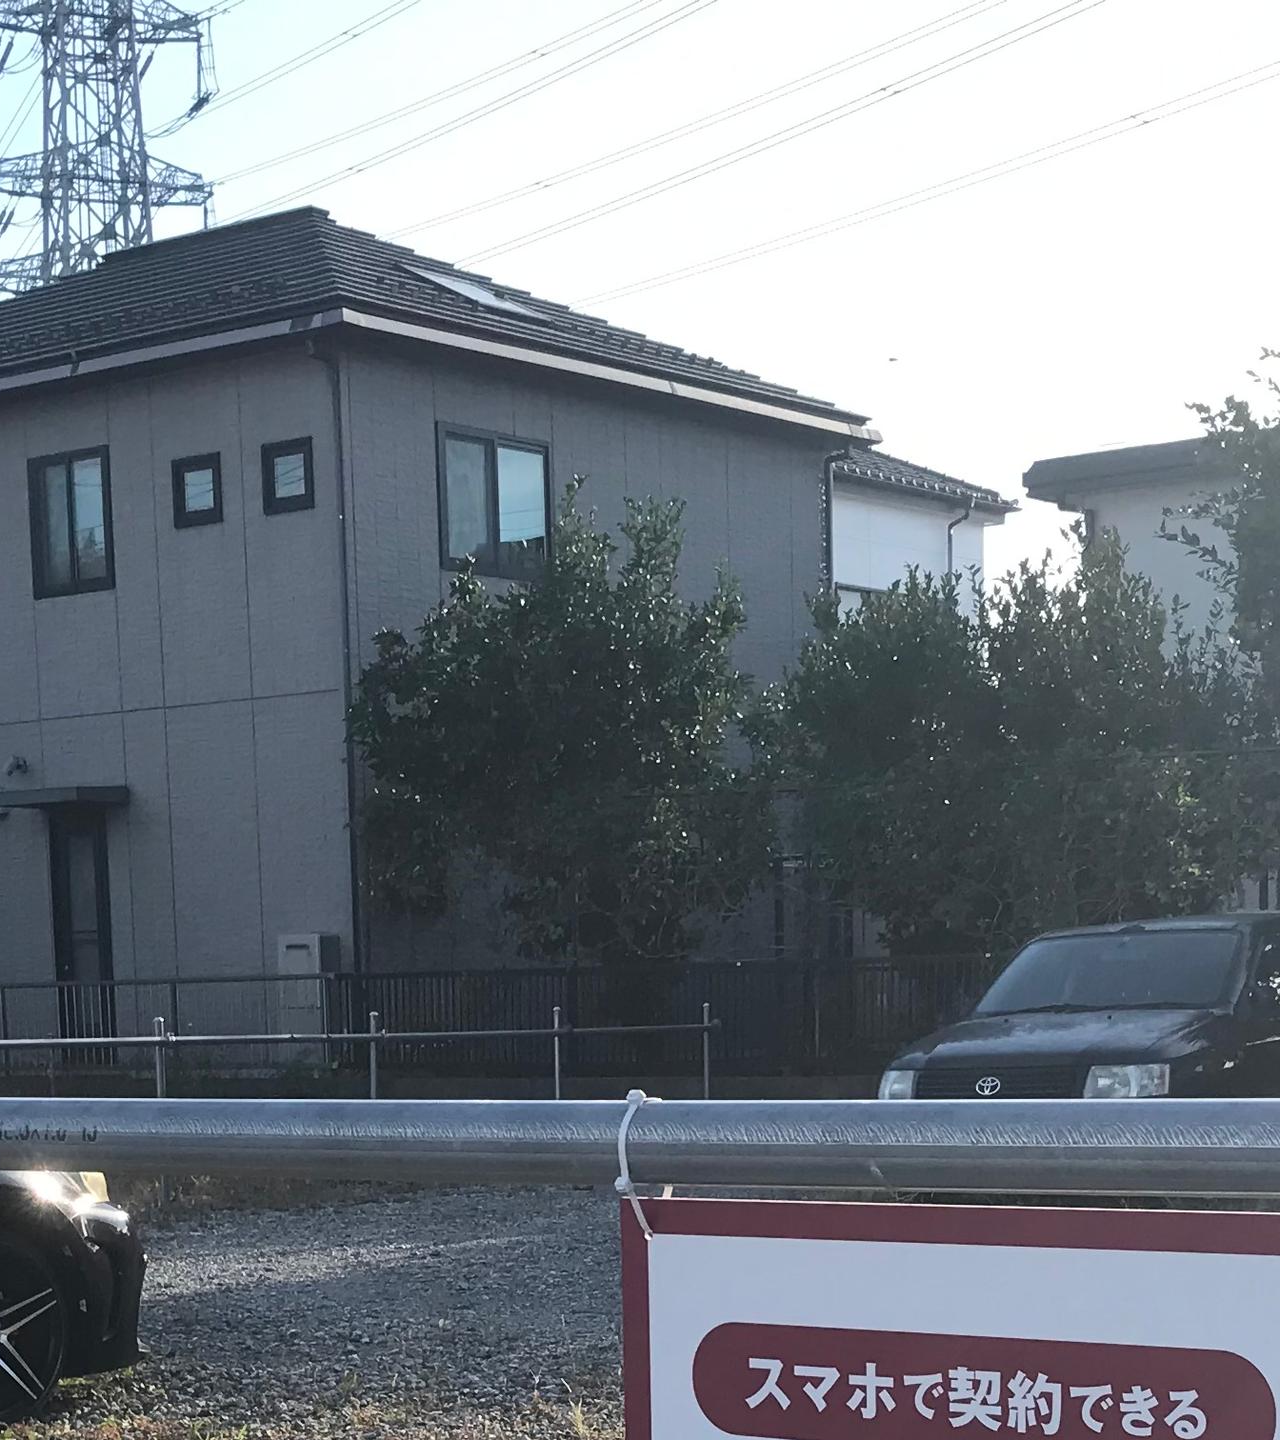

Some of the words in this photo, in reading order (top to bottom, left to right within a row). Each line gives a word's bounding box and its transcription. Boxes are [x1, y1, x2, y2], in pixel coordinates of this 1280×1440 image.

[744, 1356, 1208, 1440] スマホで契約できる
